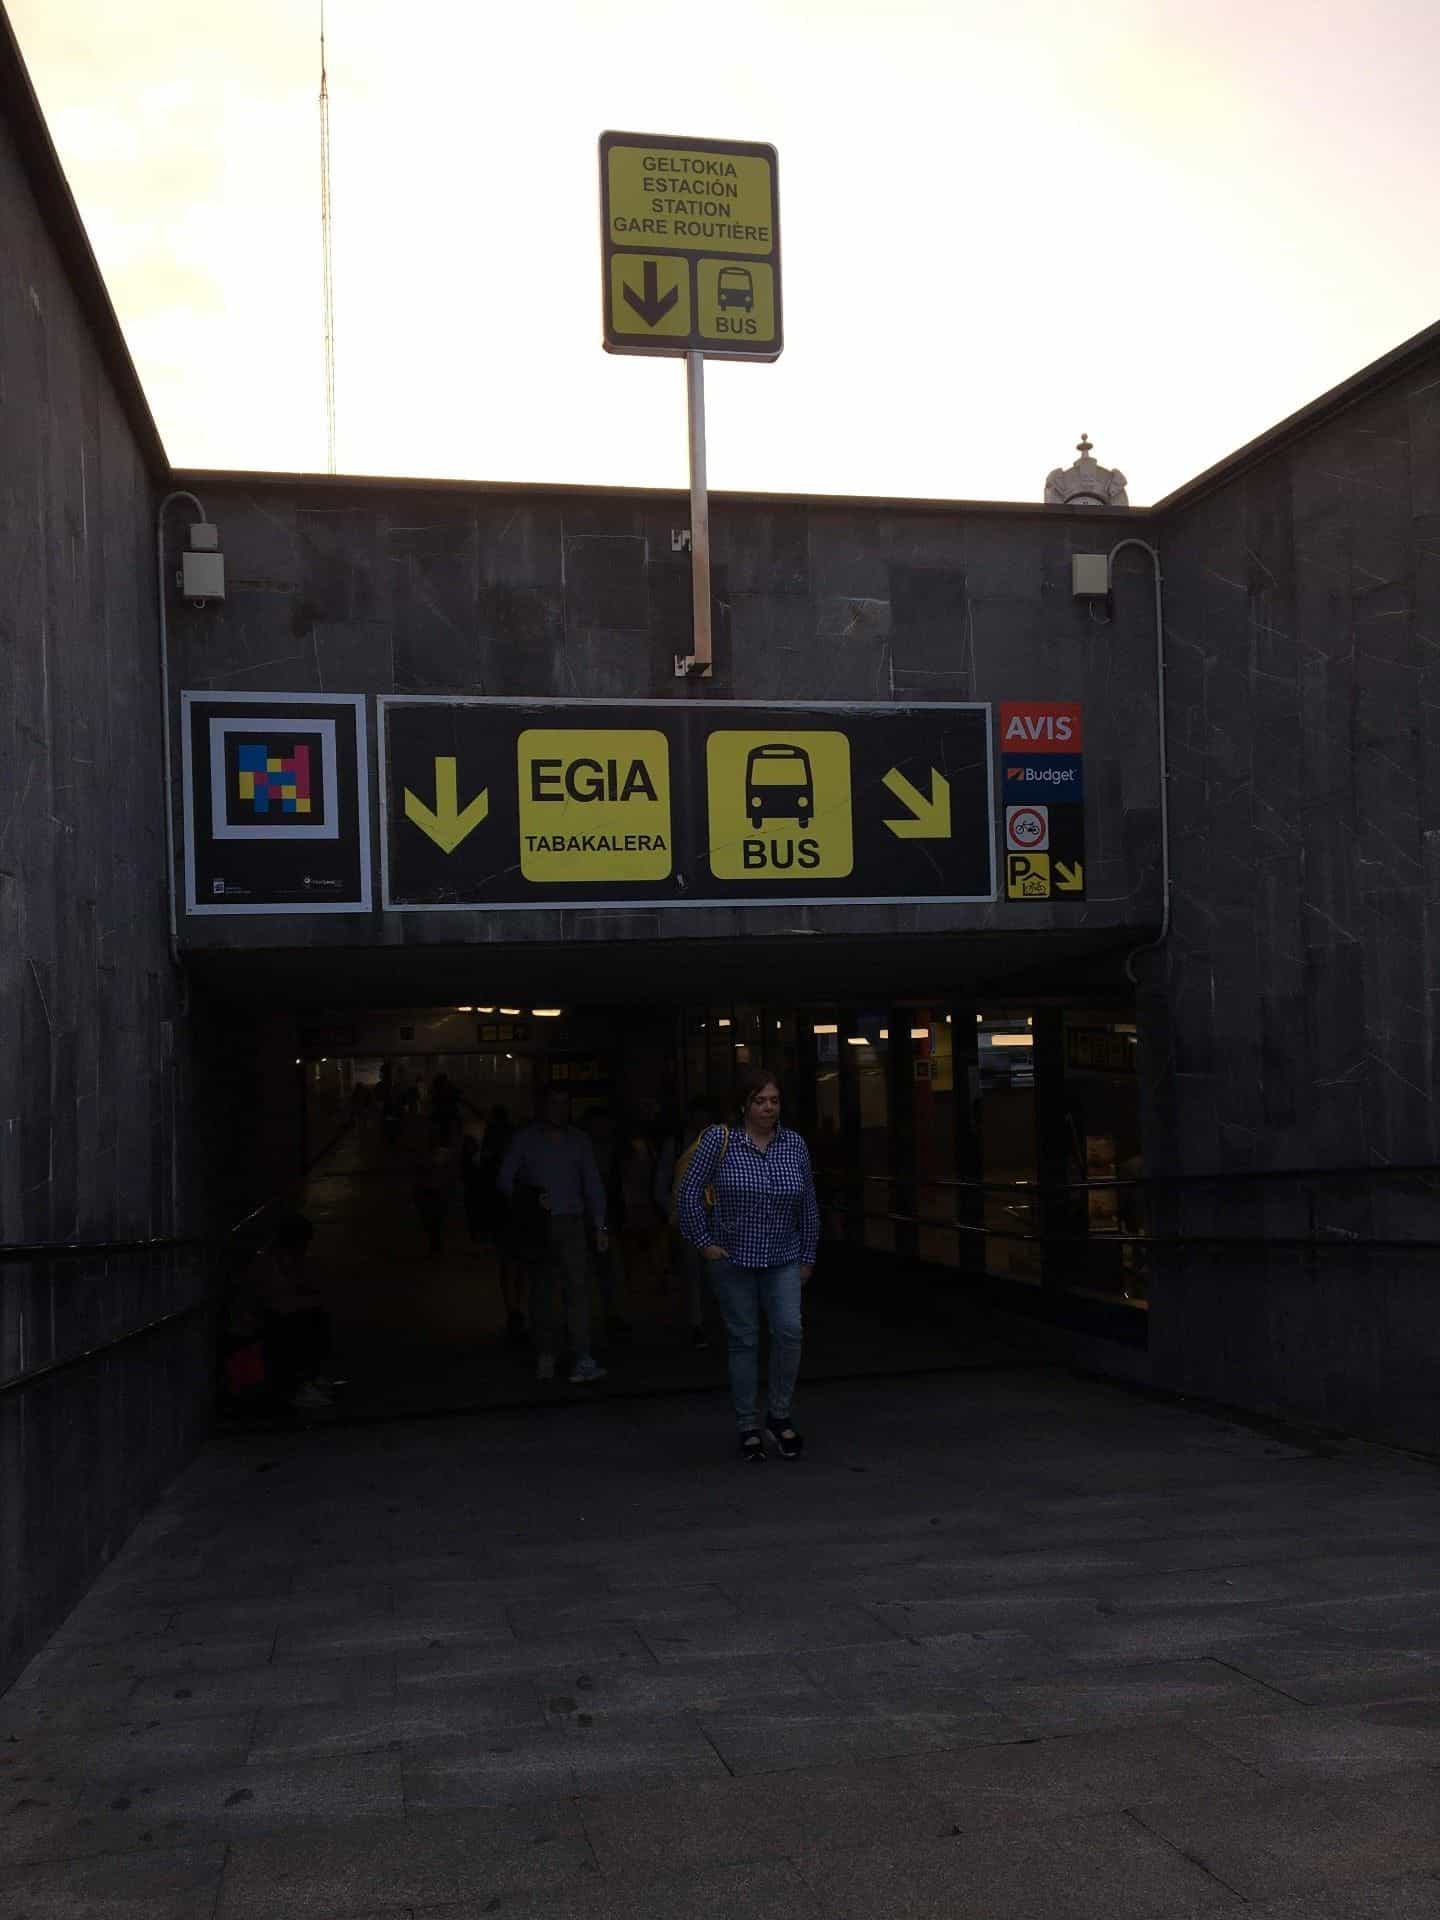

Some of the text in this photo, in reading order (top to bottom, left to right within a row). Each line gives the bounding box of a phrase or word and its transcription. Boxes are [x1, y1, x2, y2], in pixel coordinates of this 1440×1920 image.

[642, 156, 736, 177] GELTOKIA
[643, 178, 737, 198] ESTACIÓN
[651, 199, 730, 217] STATION
[614, 217, 669, 234] GARE
[716, 317, 757, 334] BUS
[1005, 716, 1073, 741] AVIS
[531, 758, 658, 802] EGIA
[1025, 767, 1074, 784] Budget
[525, 835, 667, 852] TABAKALERA
[742, 838, 821, 869] BUS
[1010, 856, 1030, 885] P
